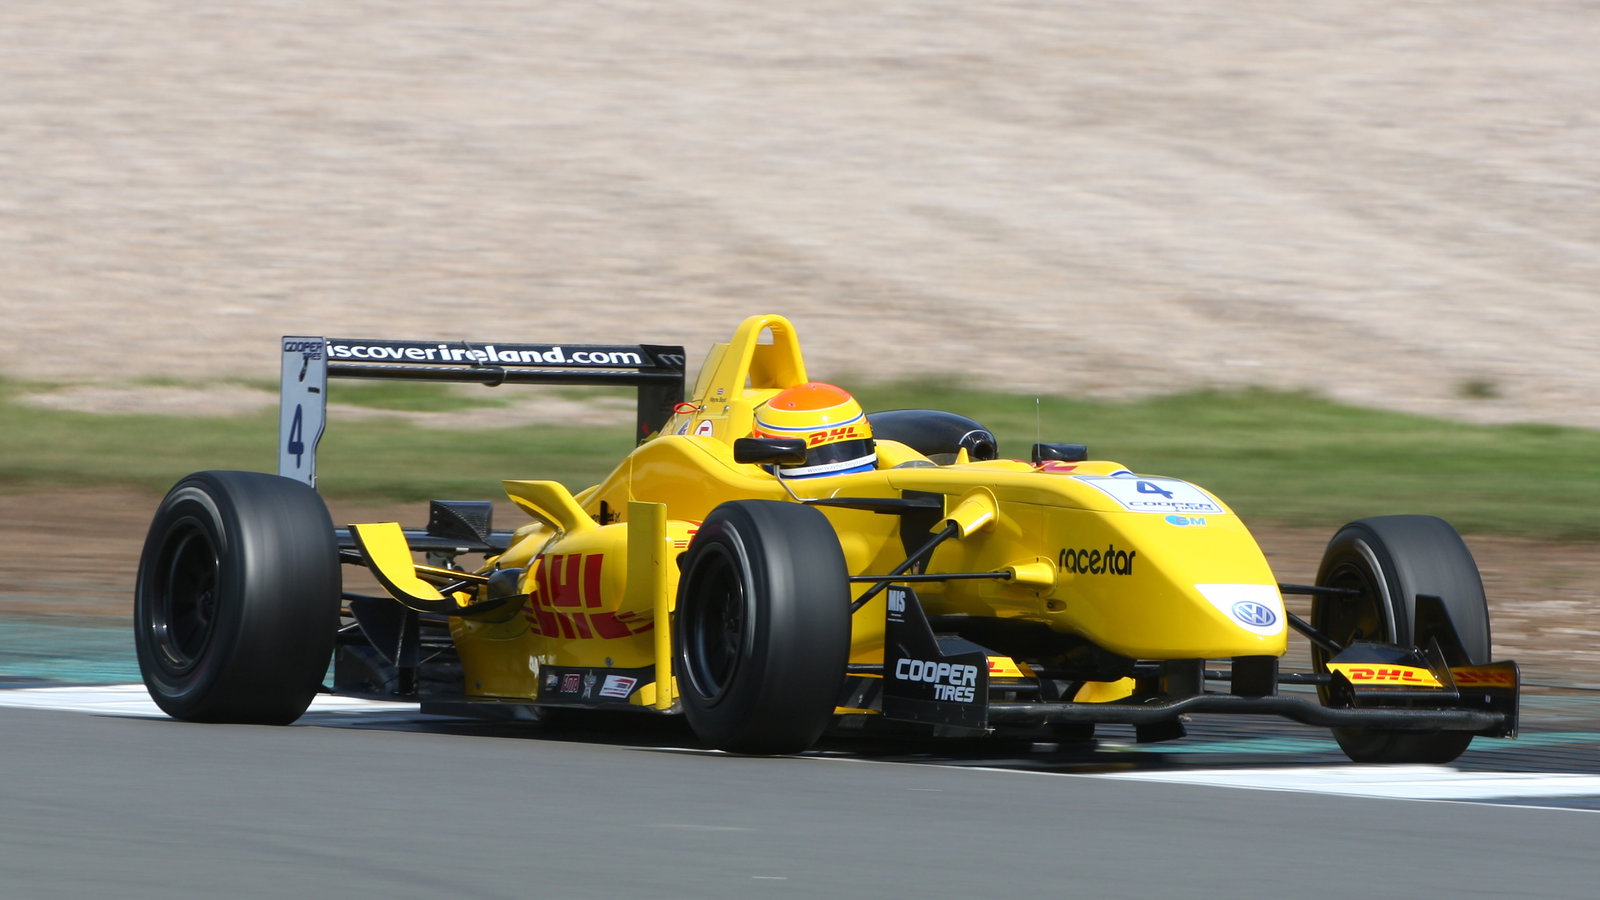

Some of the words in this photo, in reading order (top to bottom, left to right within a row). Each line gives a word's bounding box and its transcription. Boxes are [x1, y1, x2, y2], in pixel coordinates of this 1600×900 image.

[288, 403, 304, 469] 4
[808, 427, 858, 446] DHL
[1136, 481, 1173, 499] 4
[1058, 544, 1136, 575] racestar
[895, 658, 978, 687] COOPER
[1349, 668, 1423, 683] DHL
[933, 684, 976, 703] TIRES
